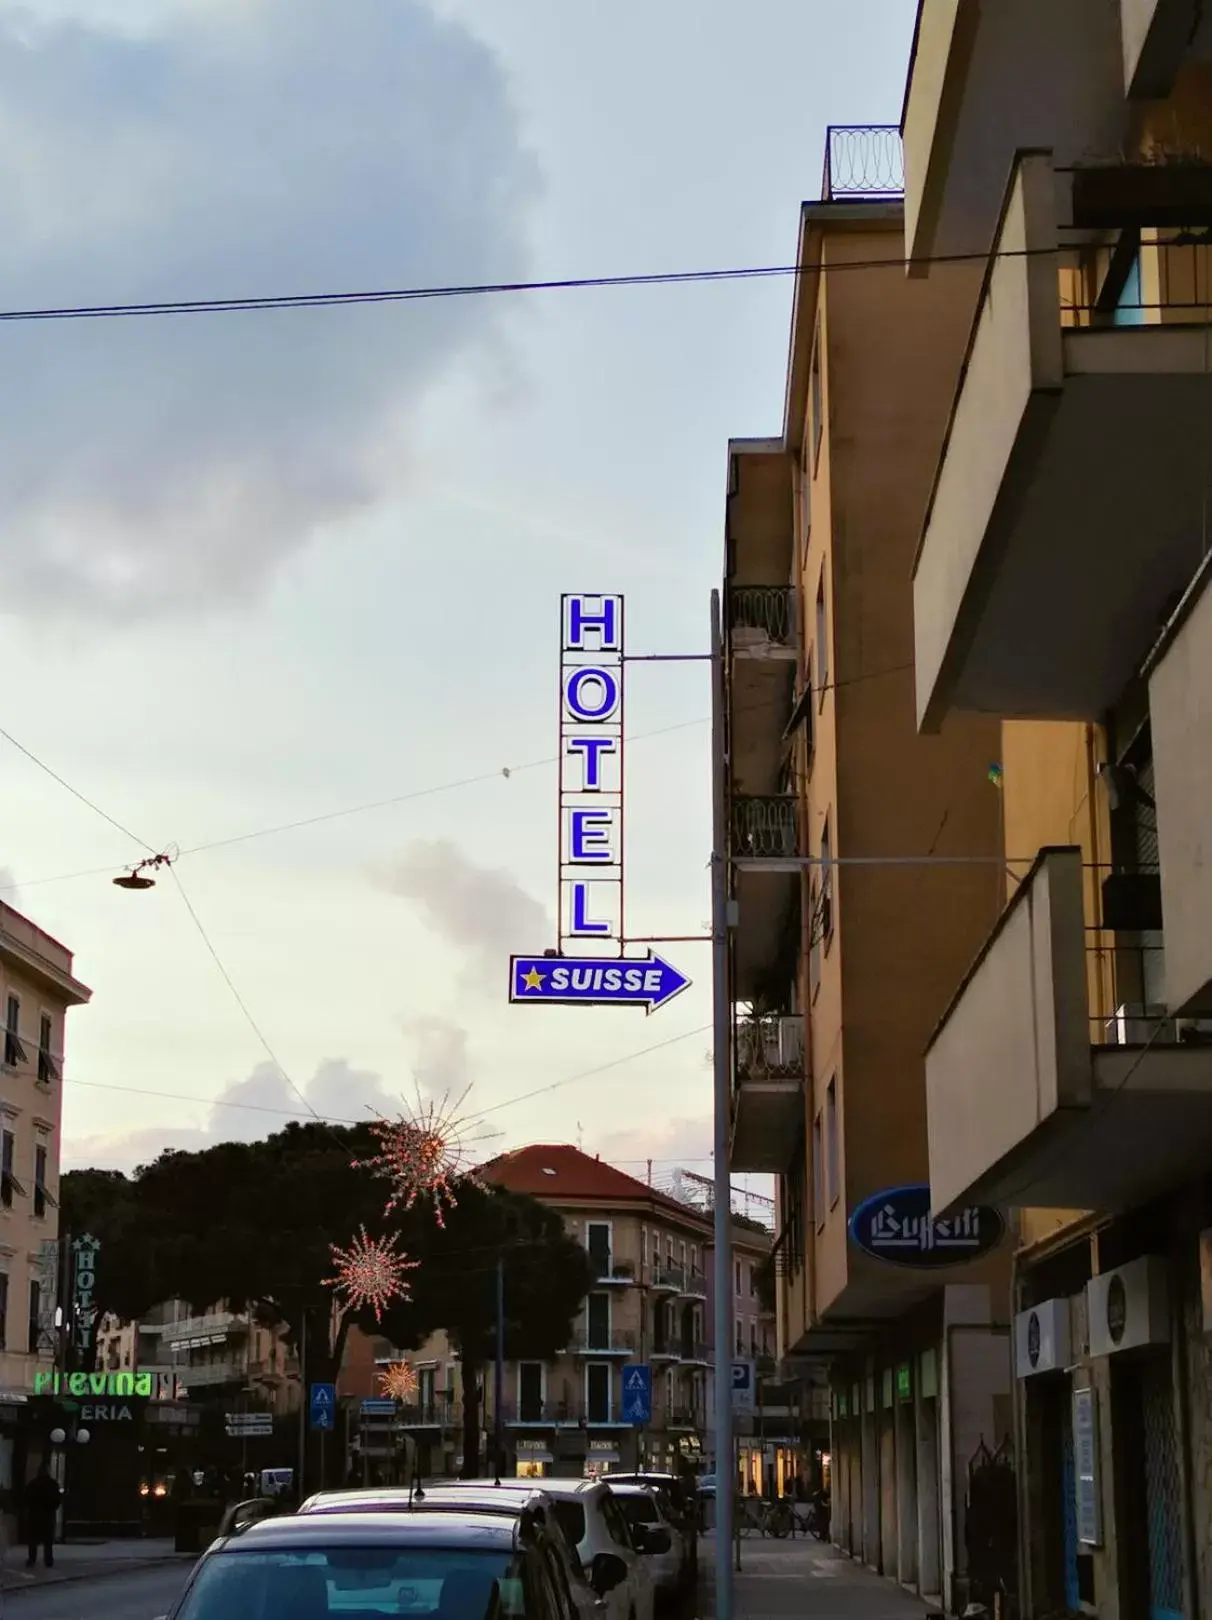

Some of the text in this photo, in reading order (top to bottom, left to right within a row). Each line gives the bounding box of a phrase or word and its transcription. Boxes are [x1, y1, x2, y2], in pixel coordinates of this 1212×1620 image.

[565, 596, 620, 937] HOTEL
[550, 967, 663, 993] SUISSE
[78, 1250, 96, 1349] HOTEL
